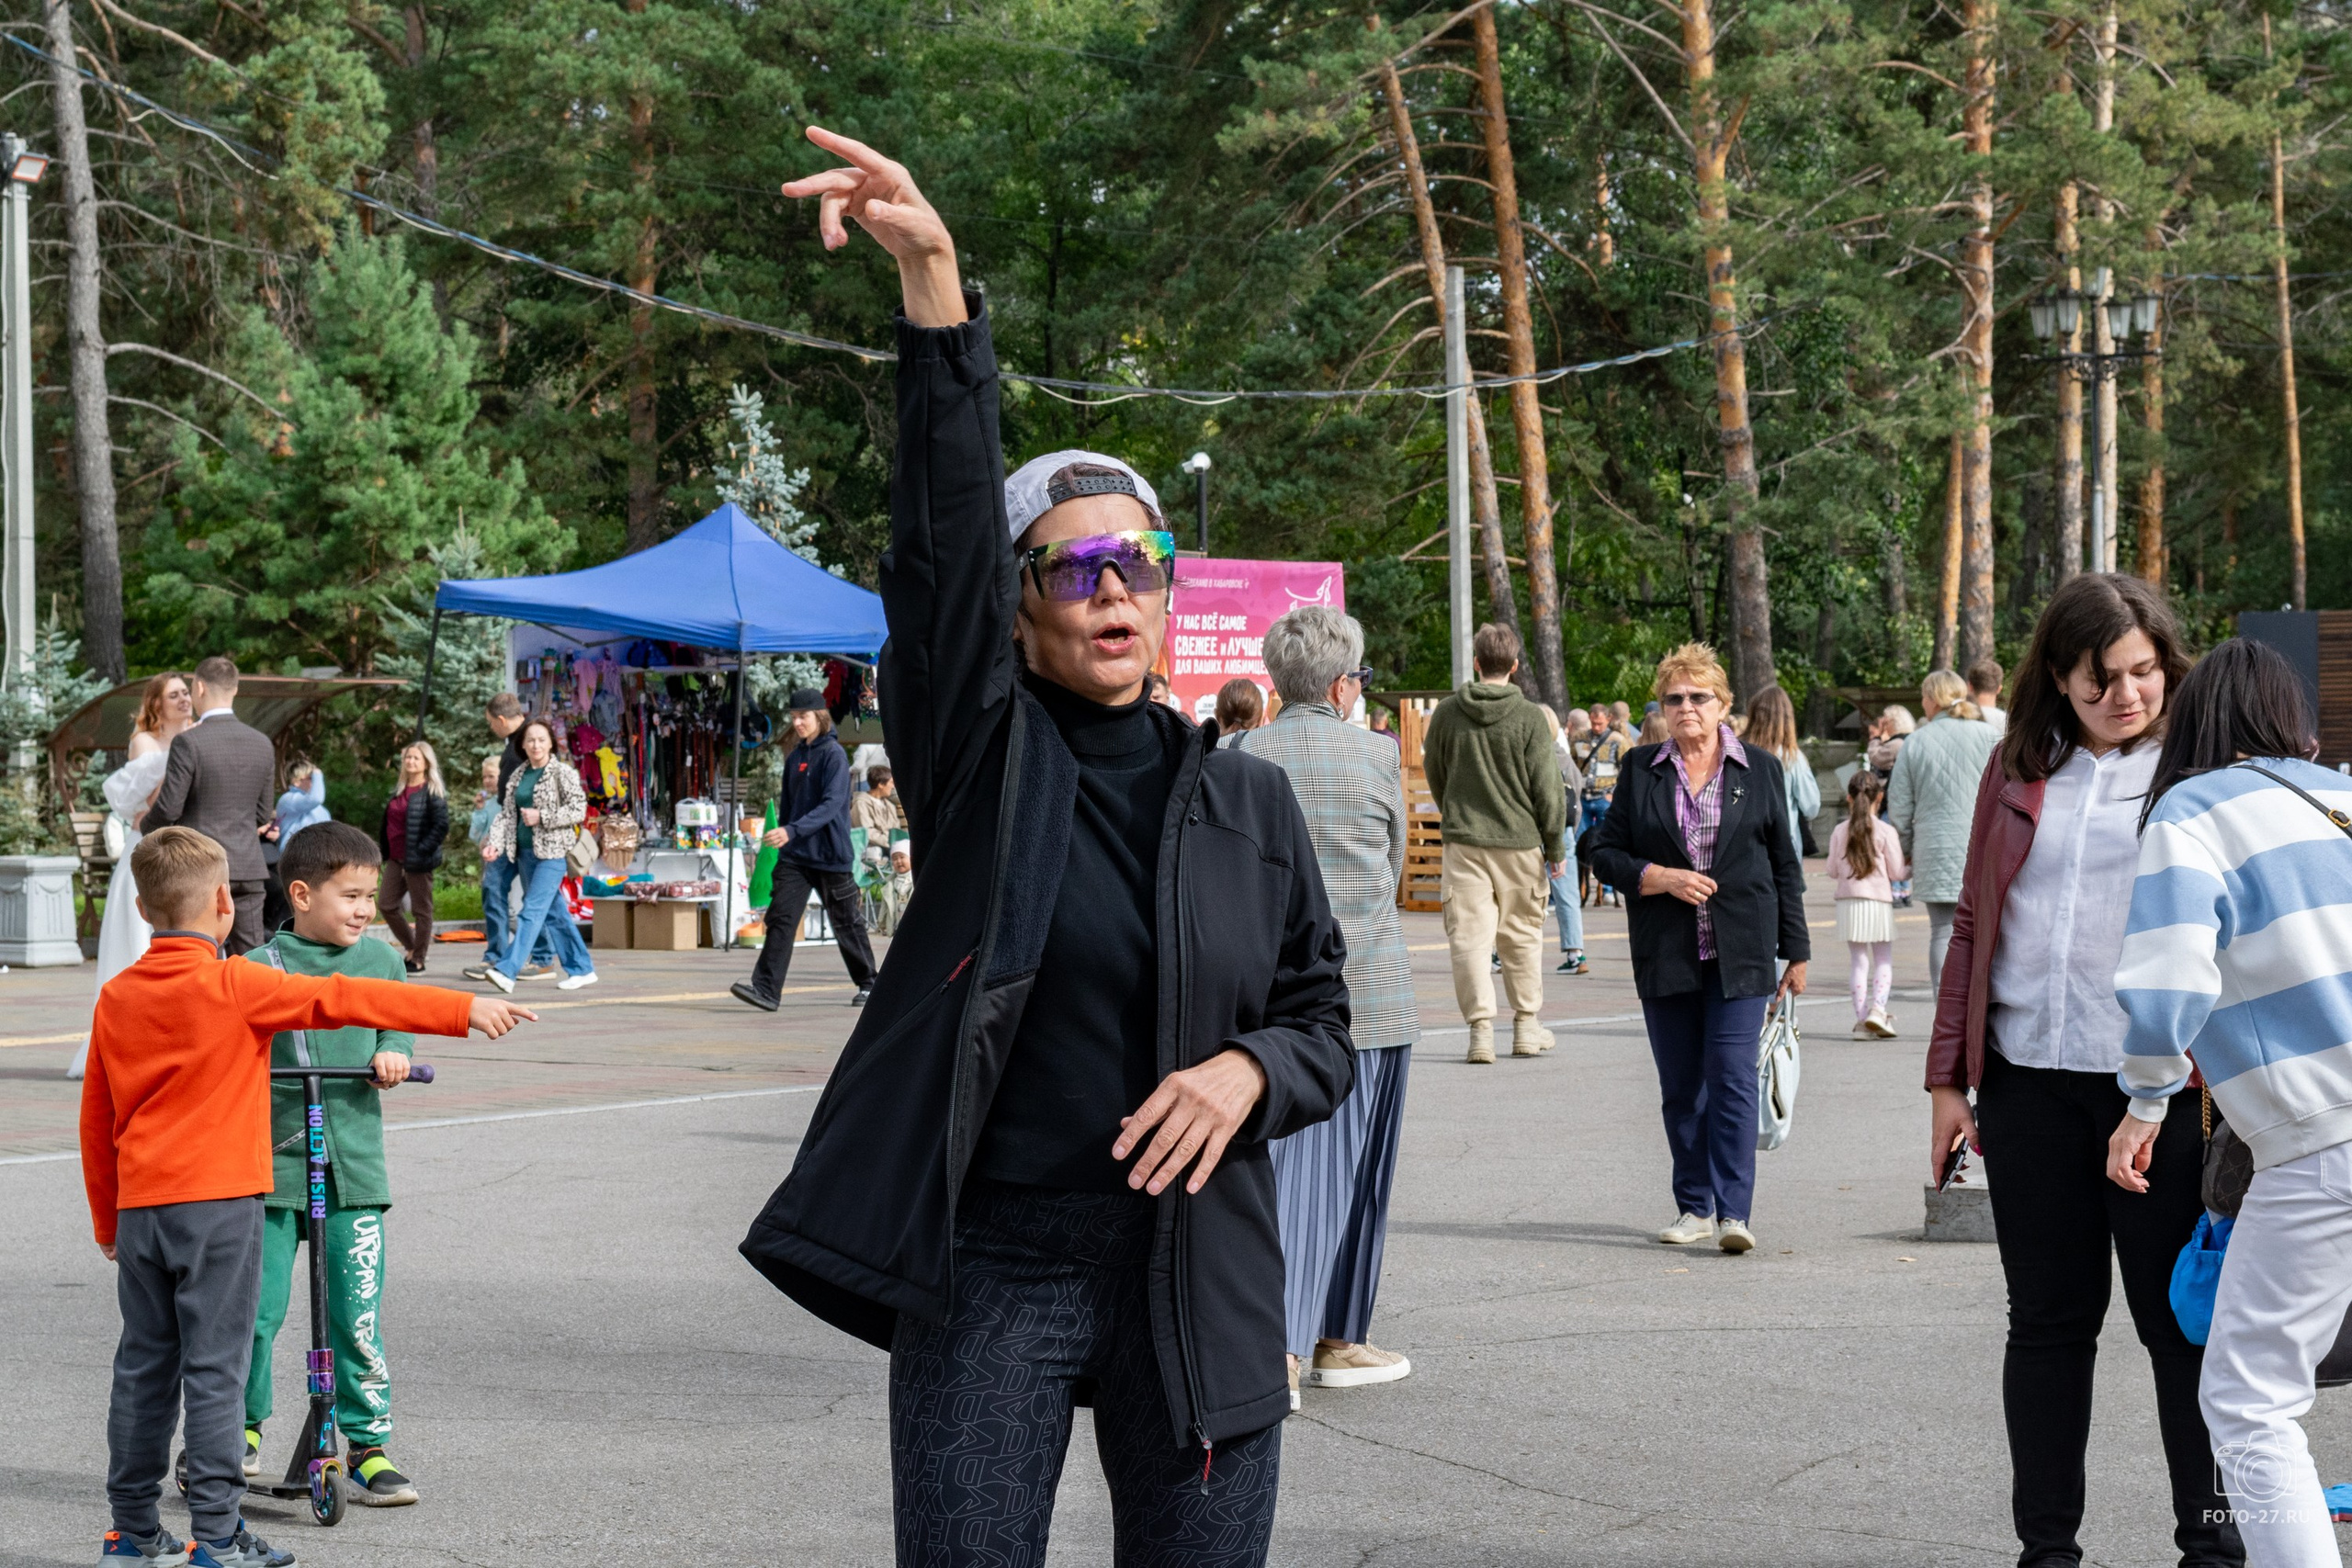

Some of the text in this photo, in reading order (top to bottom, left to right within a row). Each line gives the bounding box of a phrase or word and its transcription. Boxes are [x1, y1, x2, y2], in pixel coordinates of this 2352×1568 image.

[1176, 612, 1247, 631] У НАС ВСЁ САМОЕ
[1175, 635, 1217, 657] СВЕЖЕЕ
[1174, 660, 1192, 675] ДЛЯ
[1193, 659, 1222, 674] ВАШИХ
[308, 1104, 325, 1218] RUSH ACTION
[348, 1215, 381, 1300] URBAN
